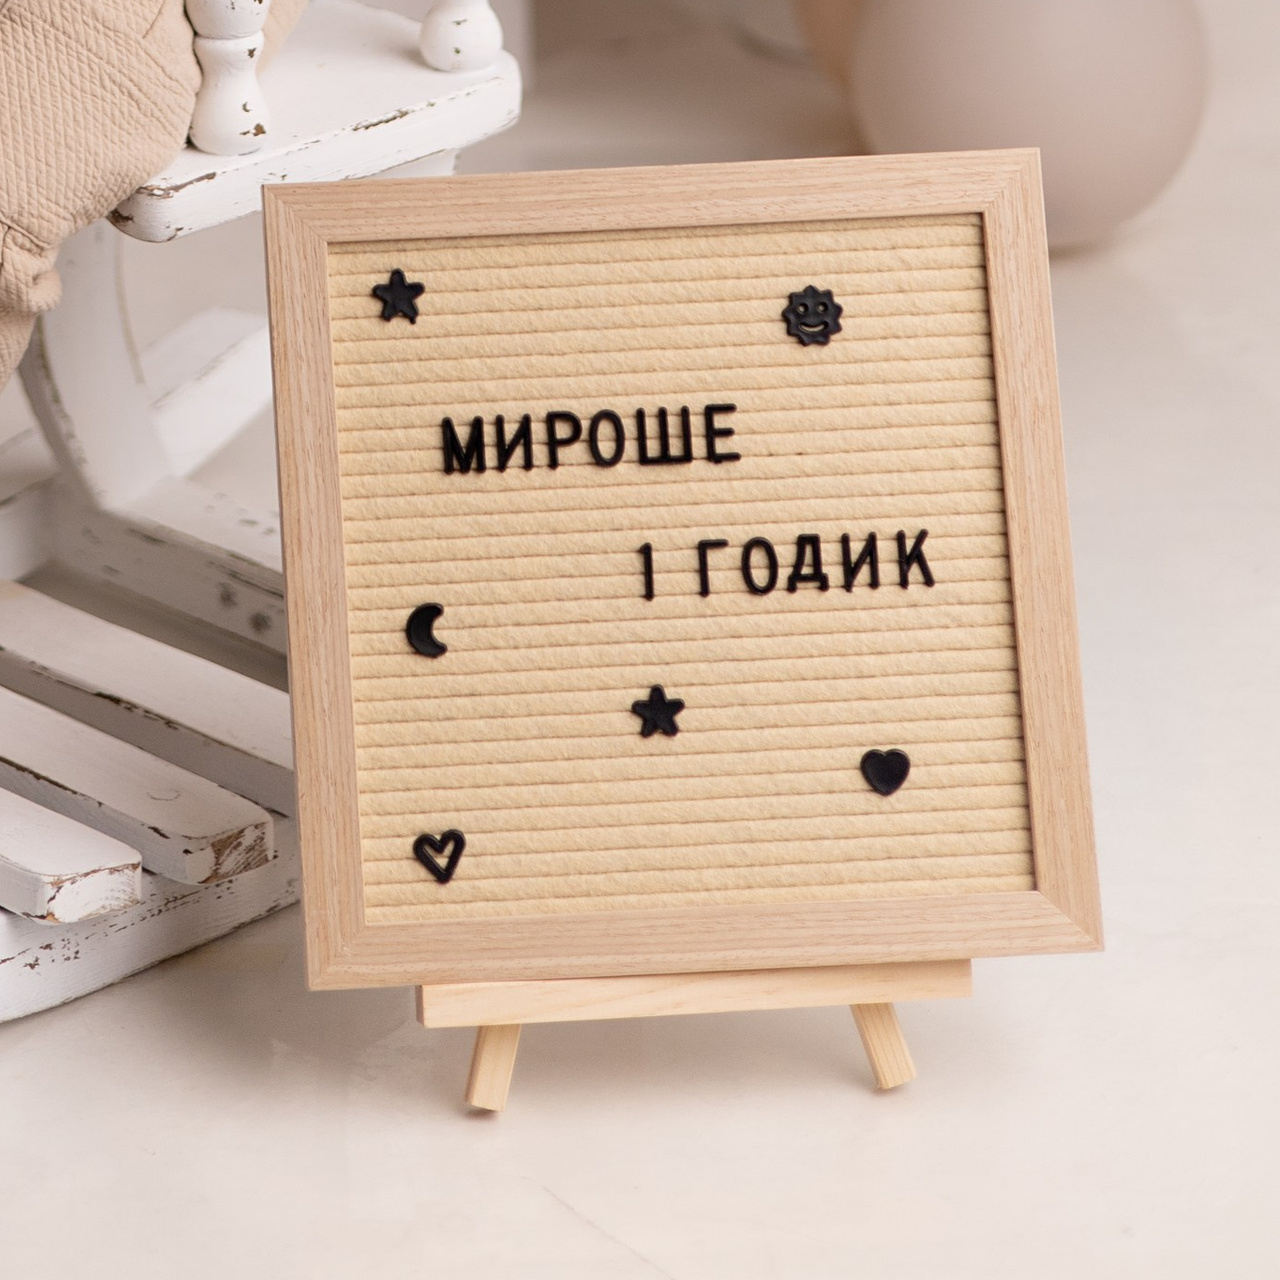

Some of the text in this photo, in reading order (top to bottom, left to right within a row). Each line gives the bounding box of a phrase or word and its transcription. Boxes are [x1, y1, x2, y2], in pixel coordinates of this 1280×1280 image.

[439, 402, 743, 476] МИРОШЕ
[636, 528, 936, 602] 1 ГОДИК
